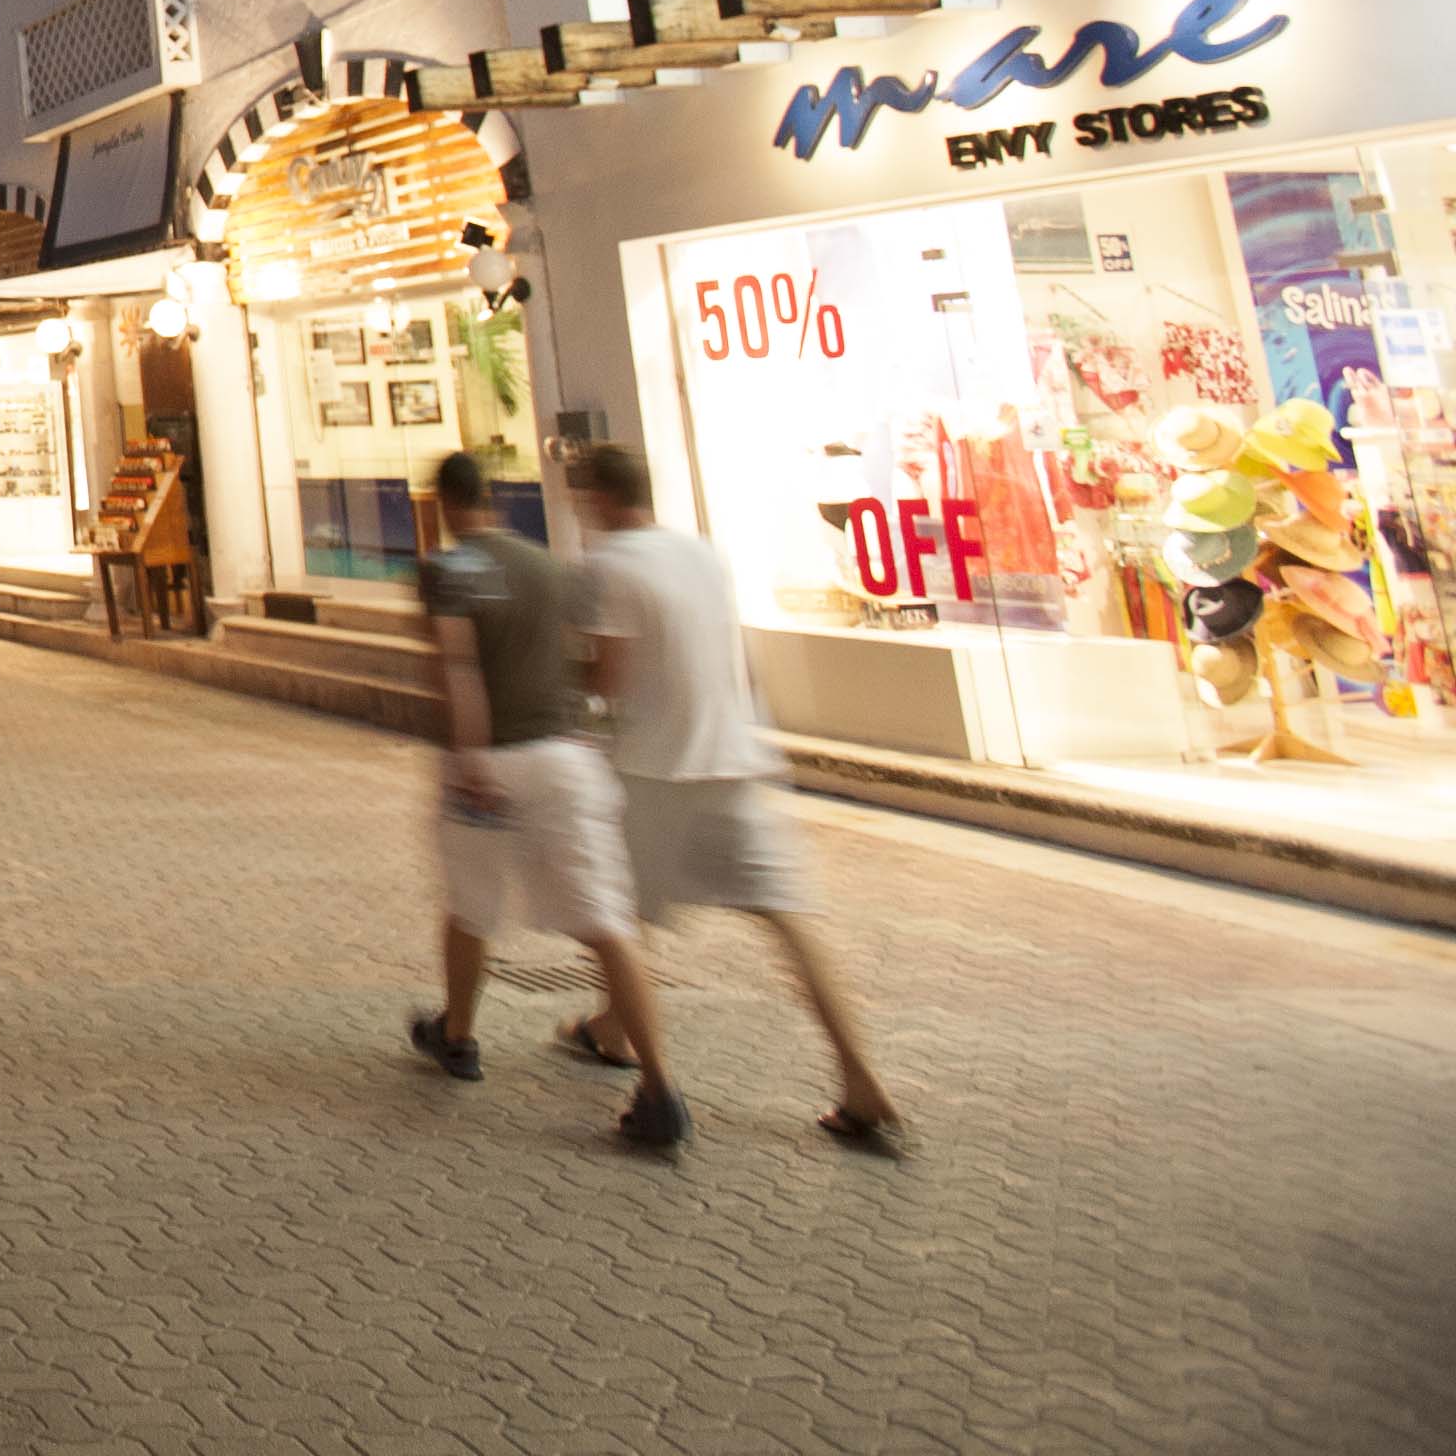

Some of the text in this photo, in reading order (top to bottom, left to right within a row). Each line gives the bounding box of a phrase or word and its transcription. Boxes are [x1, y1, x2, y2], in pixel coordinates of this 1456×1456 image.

[946, 86, 1270, 170] ENVY STORES
[696, 268, 845, 361] 50%
[849, 497, 985, 602] OFF
